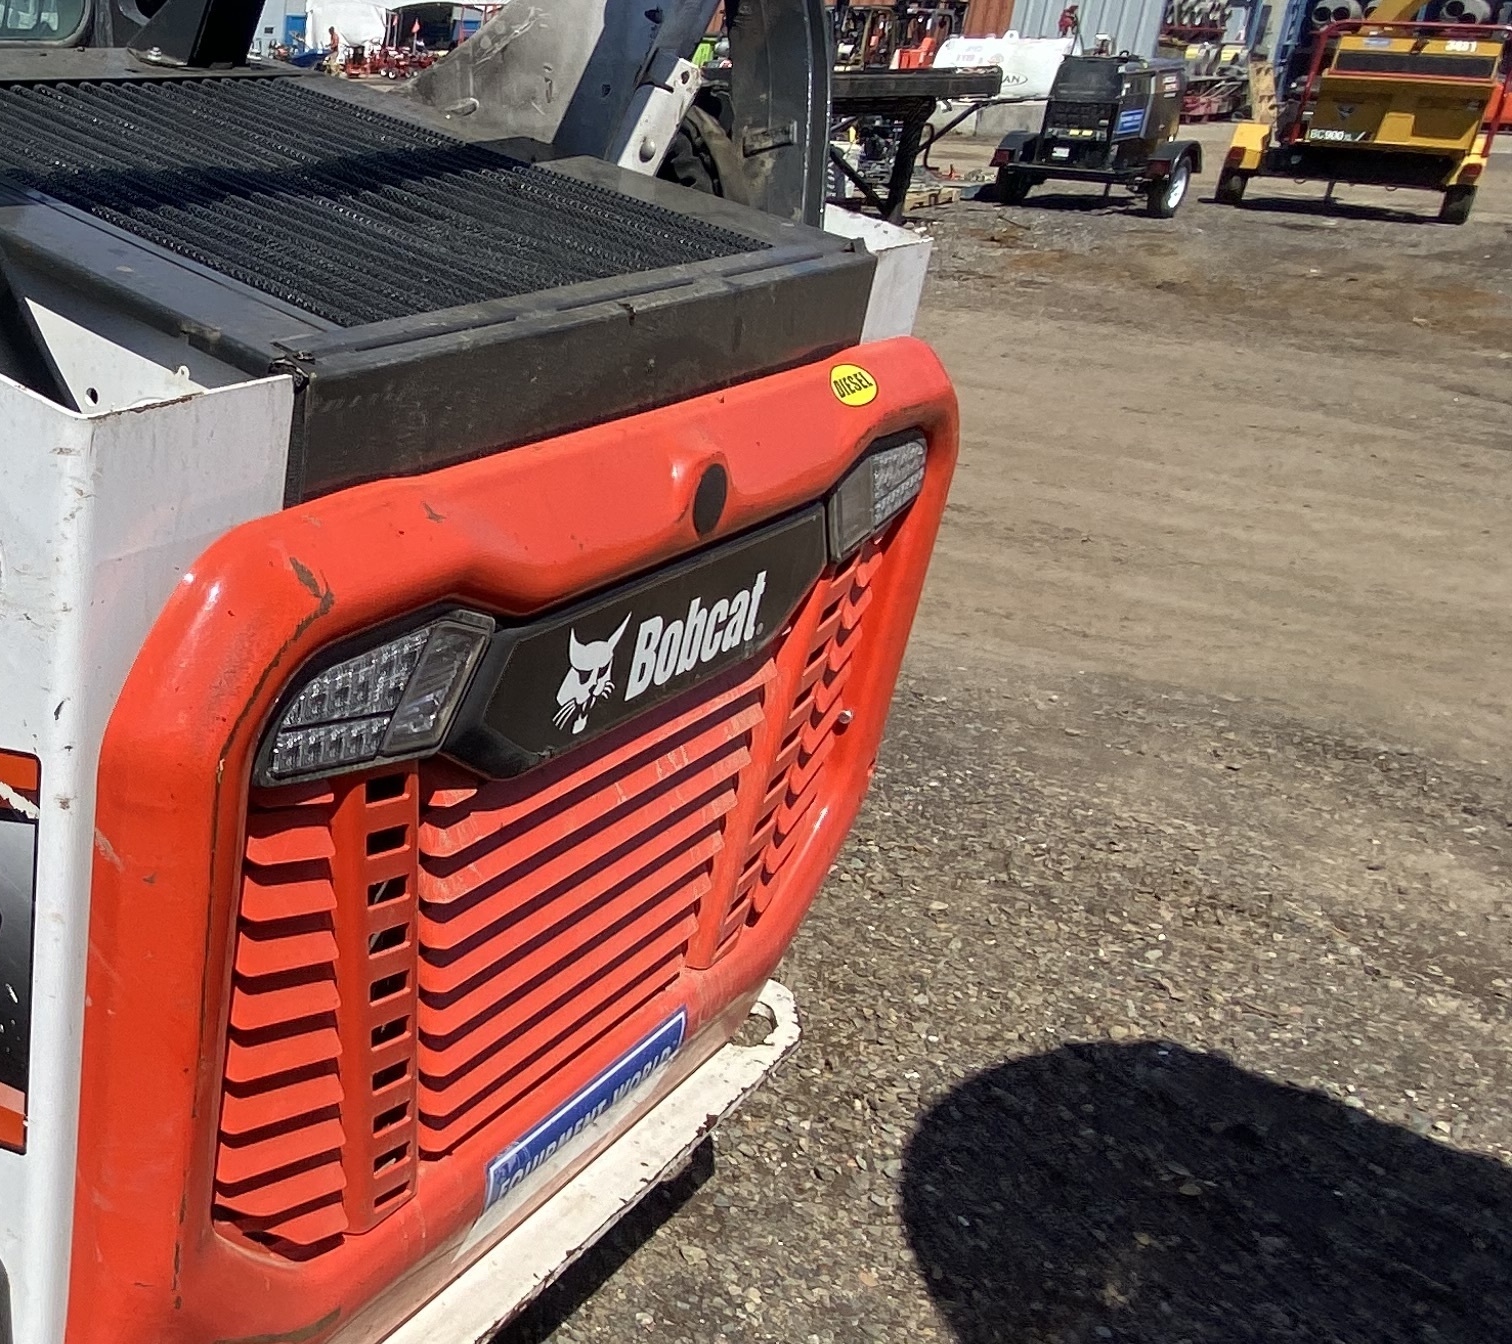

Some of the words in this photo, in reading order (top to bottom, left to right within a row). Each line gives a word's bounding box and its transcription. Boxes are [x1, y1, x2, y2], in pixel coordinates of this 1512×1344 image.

[833, 371, 874, 398] DIESEL
[624, 570, 767, 701] Bobcat
[499, 1098, 608, 1198] EQUIPMENT
